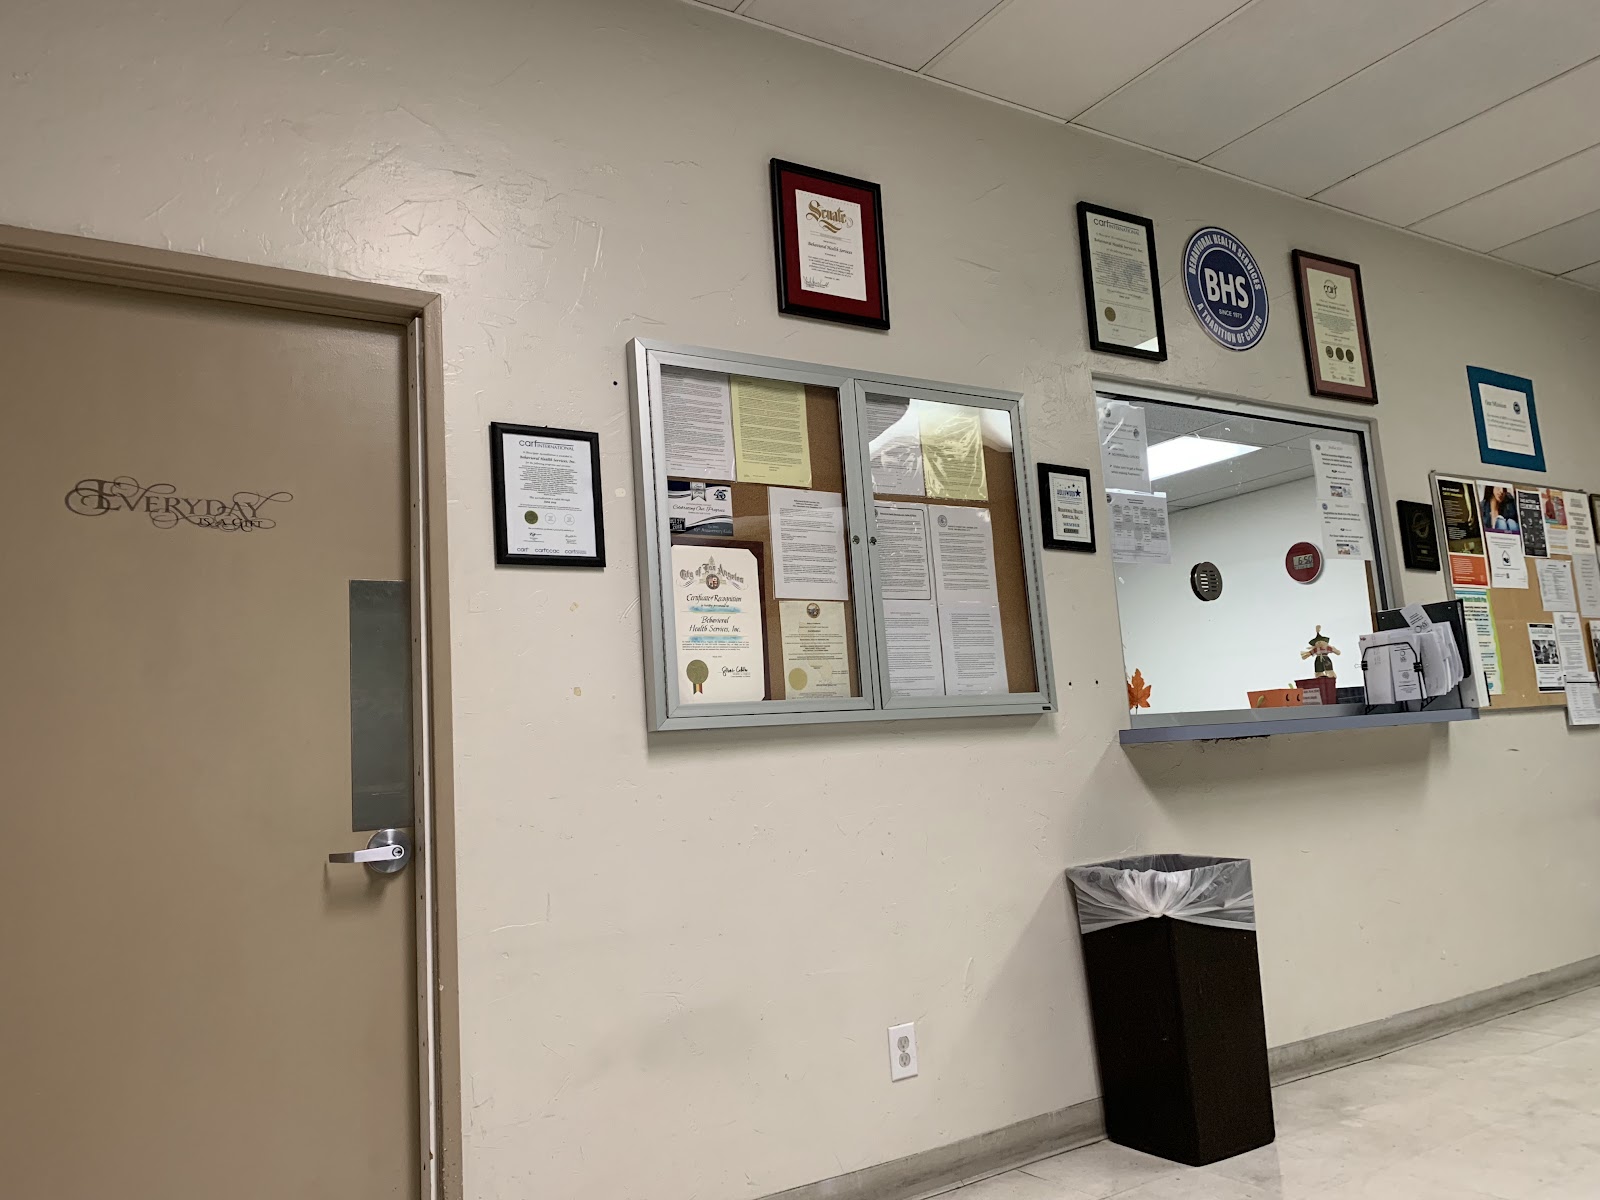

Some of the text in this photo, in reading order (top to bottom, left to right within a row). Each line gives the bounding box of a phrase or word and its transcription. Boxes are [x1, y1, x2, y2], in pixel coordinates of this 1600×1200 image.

[806, 200, 853, 233] Senate
[1189, 234, 1261, 291] BEHAVIORAL HEALTH SERVICES
[1204, 268, 1249, 308] BHS
[1197, 303, 1262, 344] A TRADITION OF CARING
[1219, 309, 1232, 317] SINCE
[64, 476, 293, 526] EVERYDAY
[680, 563, 744, 583] City of Los Angeles
[686, 594, 709, 604] Certificate
[714, 594, 742, 603] Recognition
[701, 616, 731, 624] Behavioral
